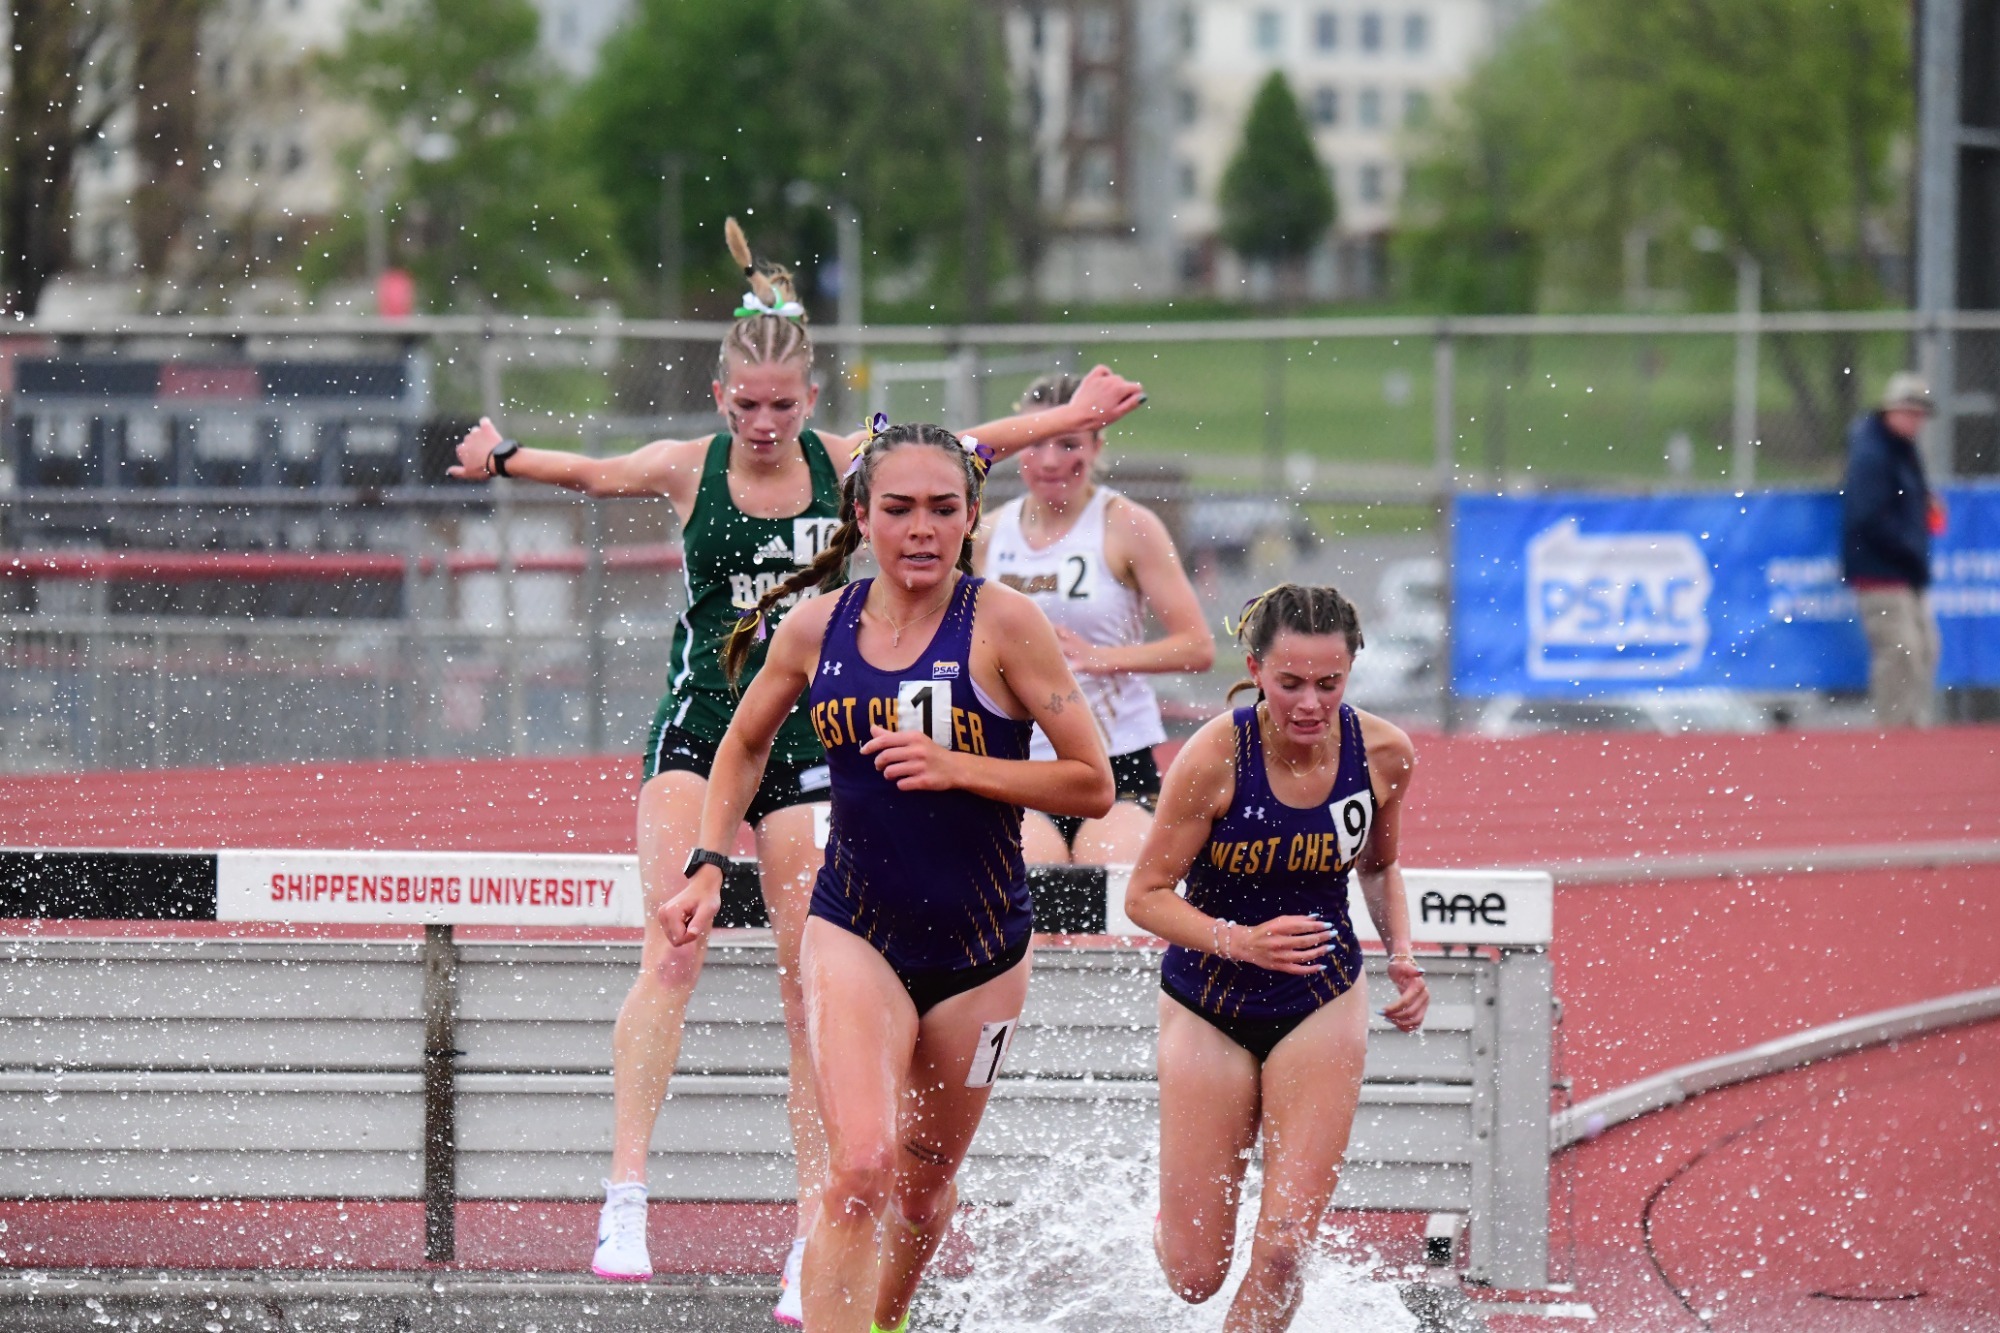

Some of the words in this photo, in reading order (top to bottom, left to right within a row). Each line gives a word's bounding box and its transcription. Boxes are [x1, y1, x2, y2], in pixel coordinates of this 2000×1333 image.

[1067, 556, 1088, 598] 2
[1541, 578, 1698, 630] PSAC
[933, 666, 959, 674] PSAC
[868, 697, 987, 756] CHER
[911, 687, 933, 741] 1
[1343, 800, 1366, 856] 9
[1211, 837, 1281, 873] WEST
[271, 874, 461, 903] SHIPPENSBURG
[470, 878, 614, 907] UNIVERSITY
[986, 1025, 1008, 1083] 1
